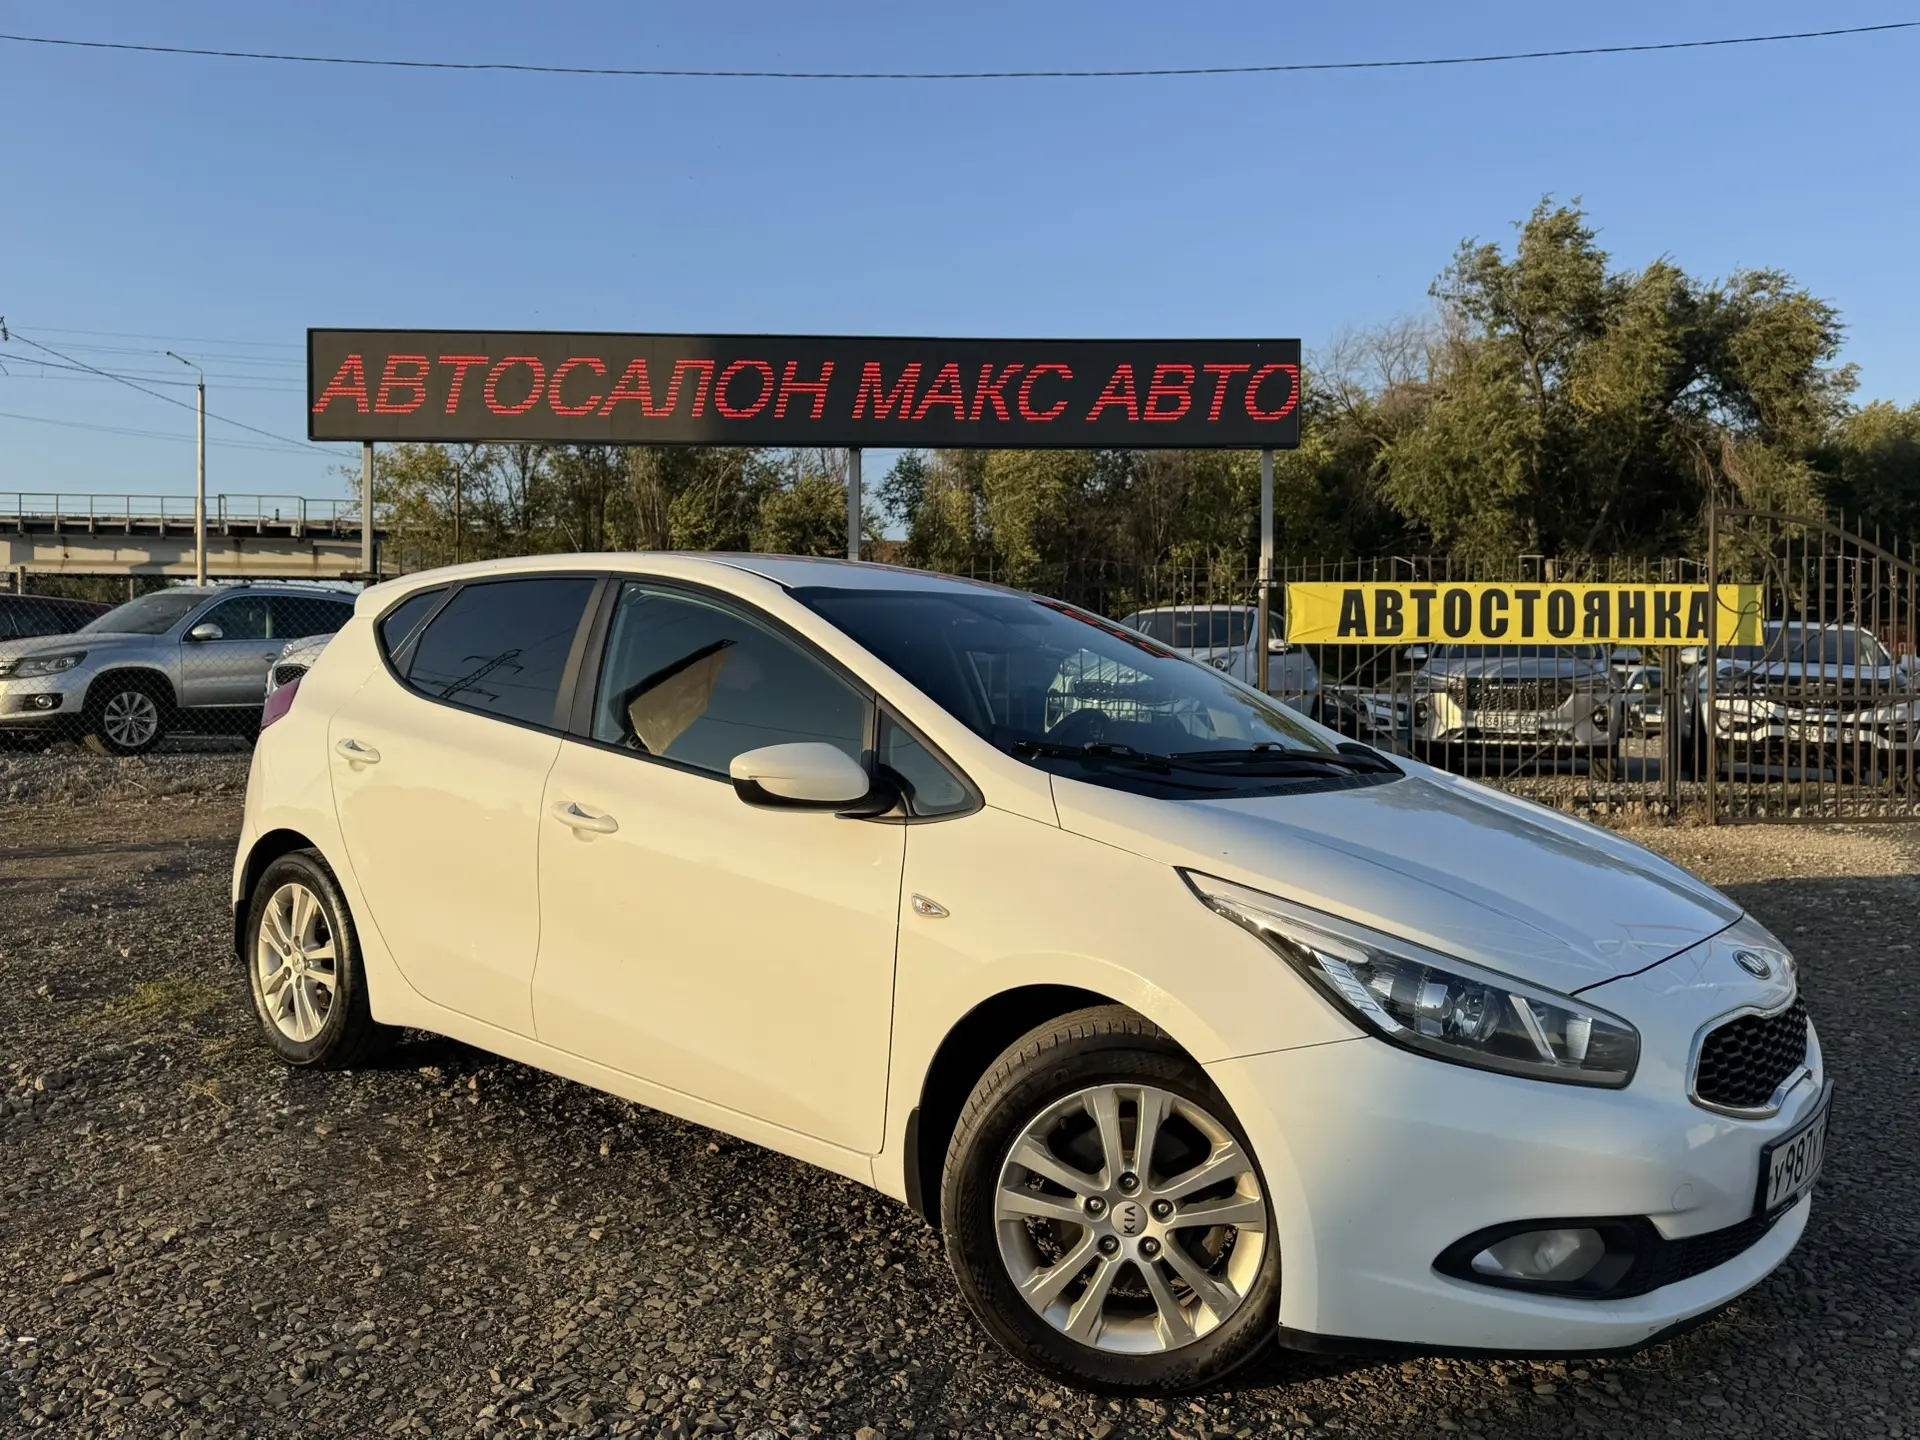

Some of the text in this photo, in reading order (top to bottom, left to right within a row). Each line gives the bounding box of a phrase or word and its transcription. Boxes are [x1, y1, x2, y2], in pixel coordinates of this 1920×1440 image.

[313, 354, 1299, 422] АВТОСАЛОН МАКС АВТО
[1337, 588, 1709, 638] АВТОСТОЯНКА
[1124, 1205, 1135, 1234] KIA
